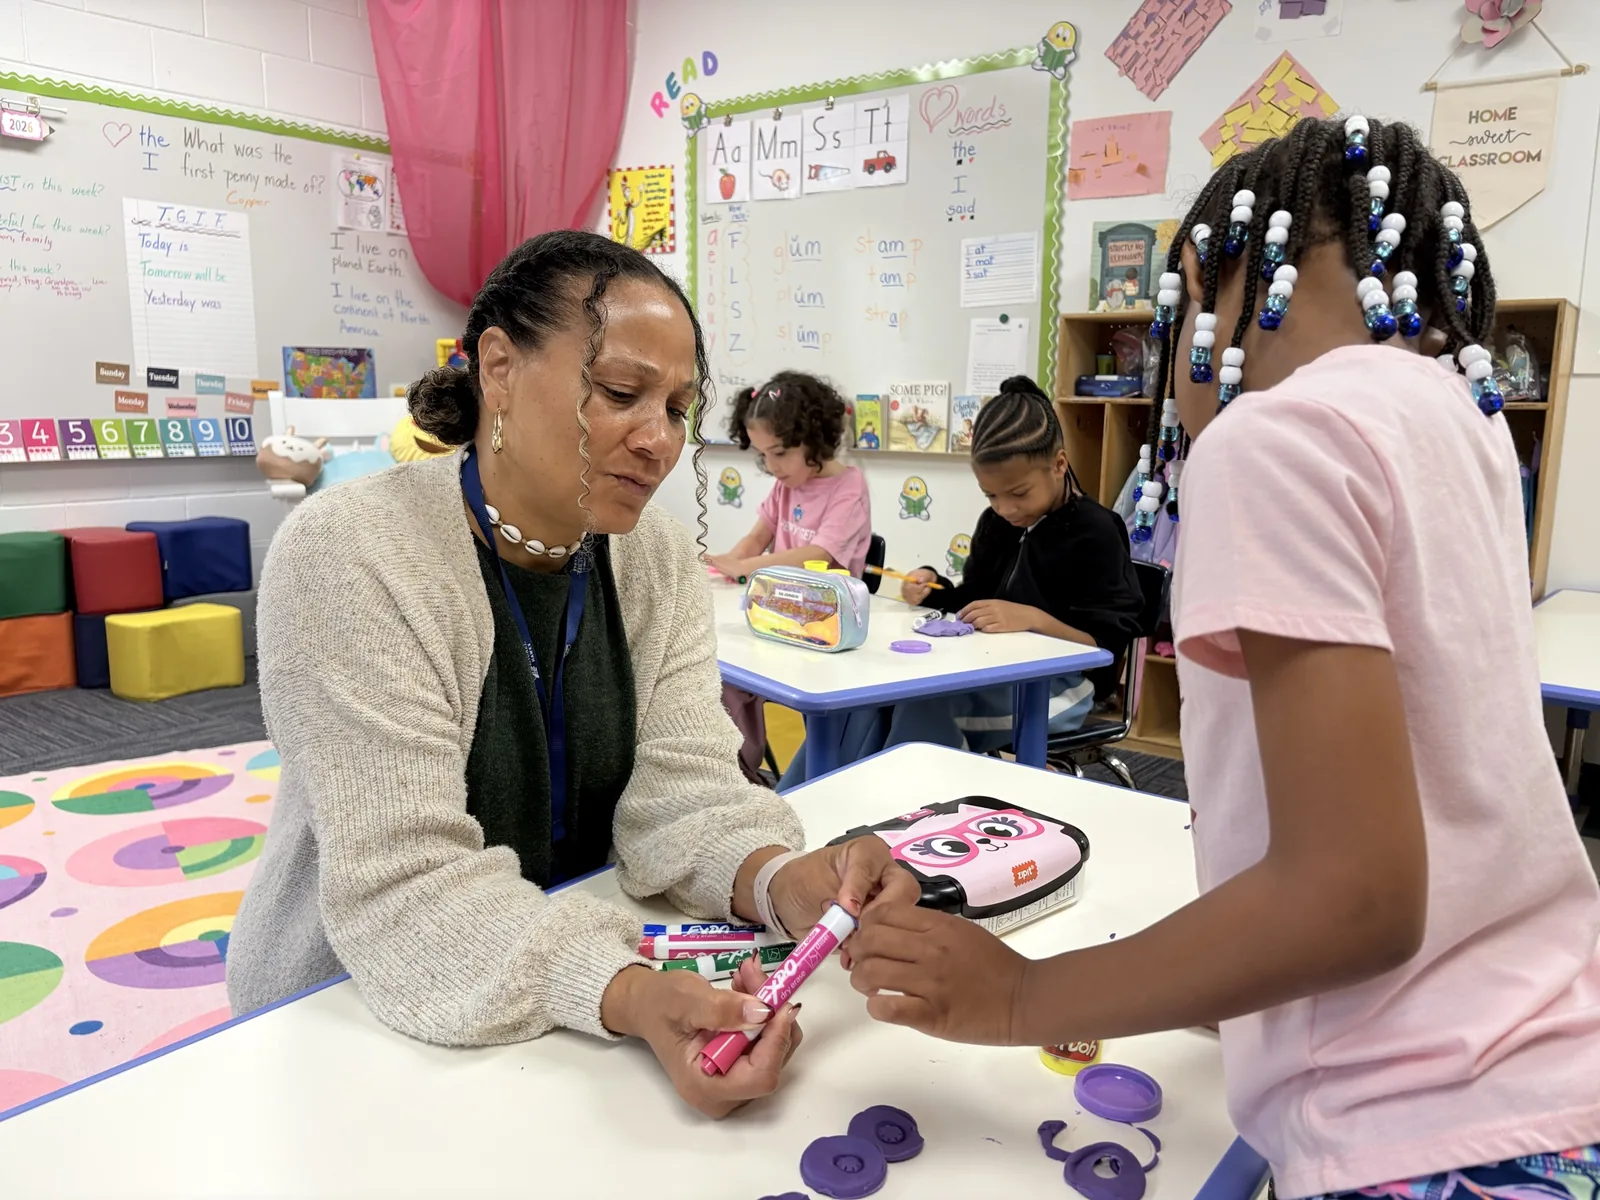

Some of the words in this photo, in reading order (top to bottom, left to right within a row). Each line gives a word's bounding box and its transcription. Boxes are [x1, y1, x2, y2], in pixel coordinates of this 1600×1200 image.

[650, 50, 719, 118] READ
[9, 118, 34, 133] 2026
[864, 105, 893, 145] Tt
[1468, 106, 1518, 124] HOME
[756, 126, 799, 161] Mm
[814, 115, 842, 151] Ss
[1456, 128, 1526, 146] sweet
[139, 125, 170, 148] the
[183, 126, 226, 154] What
[234, 145, 263, 160] was
[272, 142, 293, 165] the
[712, 132, 742, 166] Aa
[951, 140, 977, 158] the
[180, 152, 215, 180] first
[223, 168, 260, 192] penny
[264, 173, 296, 190] made
[303, 175, 327, 195] of?
[42, 176, 62, 193] this
[225, 189, 270, 209] Copper
[945, 201, 977, 217] said
[21, 231, 53, 252] family
[138, 232, 172, 258] Today
[179, 241, 189, 253] is
[356, 235, 381, 256] live
[388, 248, 409, 261] on
[728, 231, 743, 250] F
[139, 260, 192, 281] Tomorrow
[194, 267, 211, 281] will
[143, 288, 196, 312] Yesterday
[201, 298, 222, 310] was
[99, 367, 126, 379] Sunday
[149, 372, 178, 385] Tuesday
[196, 379, 224, 390] Thursday
[889, 384, 922, 396] SOME
[923, 383, 948, 396] PIG!
[117, 396, 145, 408] Monday
[168, 402, 197, 412] Wednesday
[227, 397, 251, 409] Friday
[0, 422, 14, 444] 3
[31, 422, 50, 444] 4
[68, 421, 86, 443] 5
[101, 421, 119, 443] 6
[133, 421, 149, 443] 7
[167, 421, 185, 442] 8
[198, 420, 215, 441] 9
[228, 419, 249, 440] 10
[756, 958, 798, 1005] EXPO
[780, 987, 792, 1000] dry
[790, 970, 806, 989] erase
